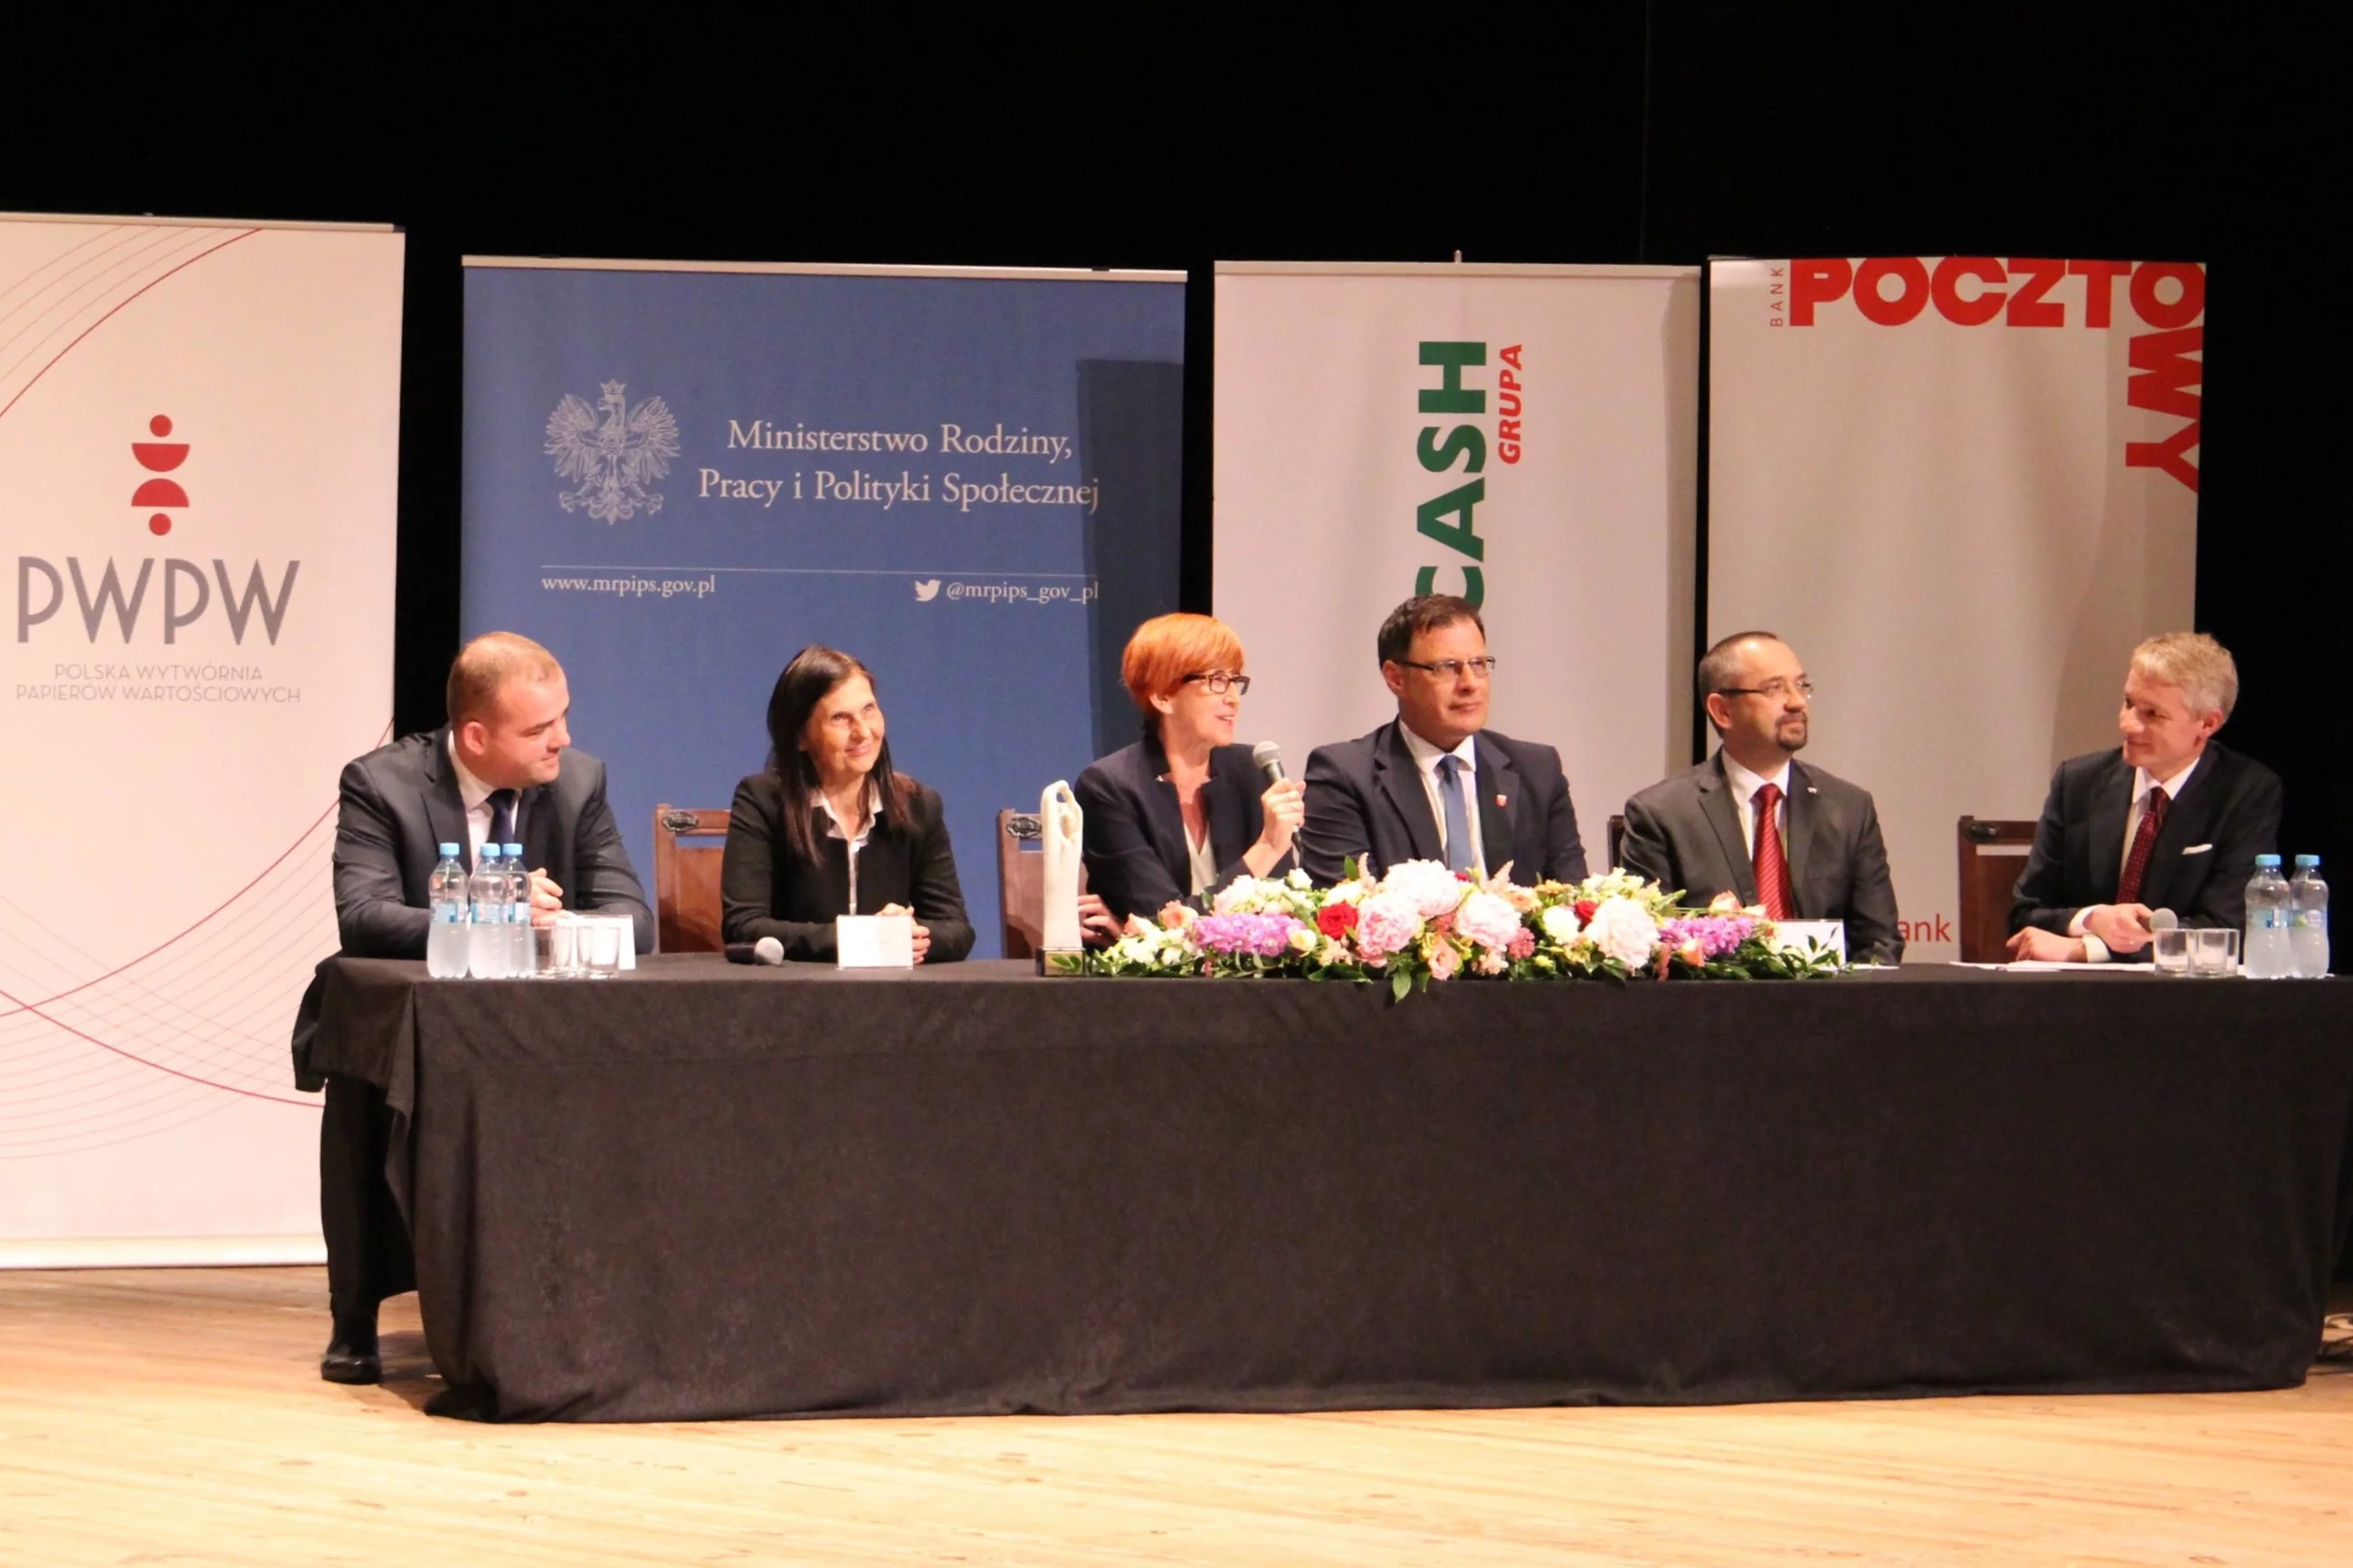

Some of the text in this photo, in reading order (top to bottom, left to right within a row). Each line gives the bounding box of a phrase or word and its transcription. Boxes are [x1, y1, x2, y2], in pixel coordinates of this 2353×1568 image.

[1770, 267, 1784, 327] BANK
[1499, 344, 1522, 464] GRUPA
[728, 419, 1072, 461] Ministerstwo Rodziny,
[699, 469, 1099, 514] Pracy i Polityki Społecznej
[17, 556, 300, 646] PWPW
[542, 575, 716, 598] www.mrpips.gov.pl
[946, 581, 1099, 604] @mrpips_gov_pl
[54, 661, 262, 681] POLSKA WYTWÓRNIA
[16, 682, 300, 703] PAPIERÓW WARTOŚCIOWYCH
[1898, 913, 1952, 942] ank
